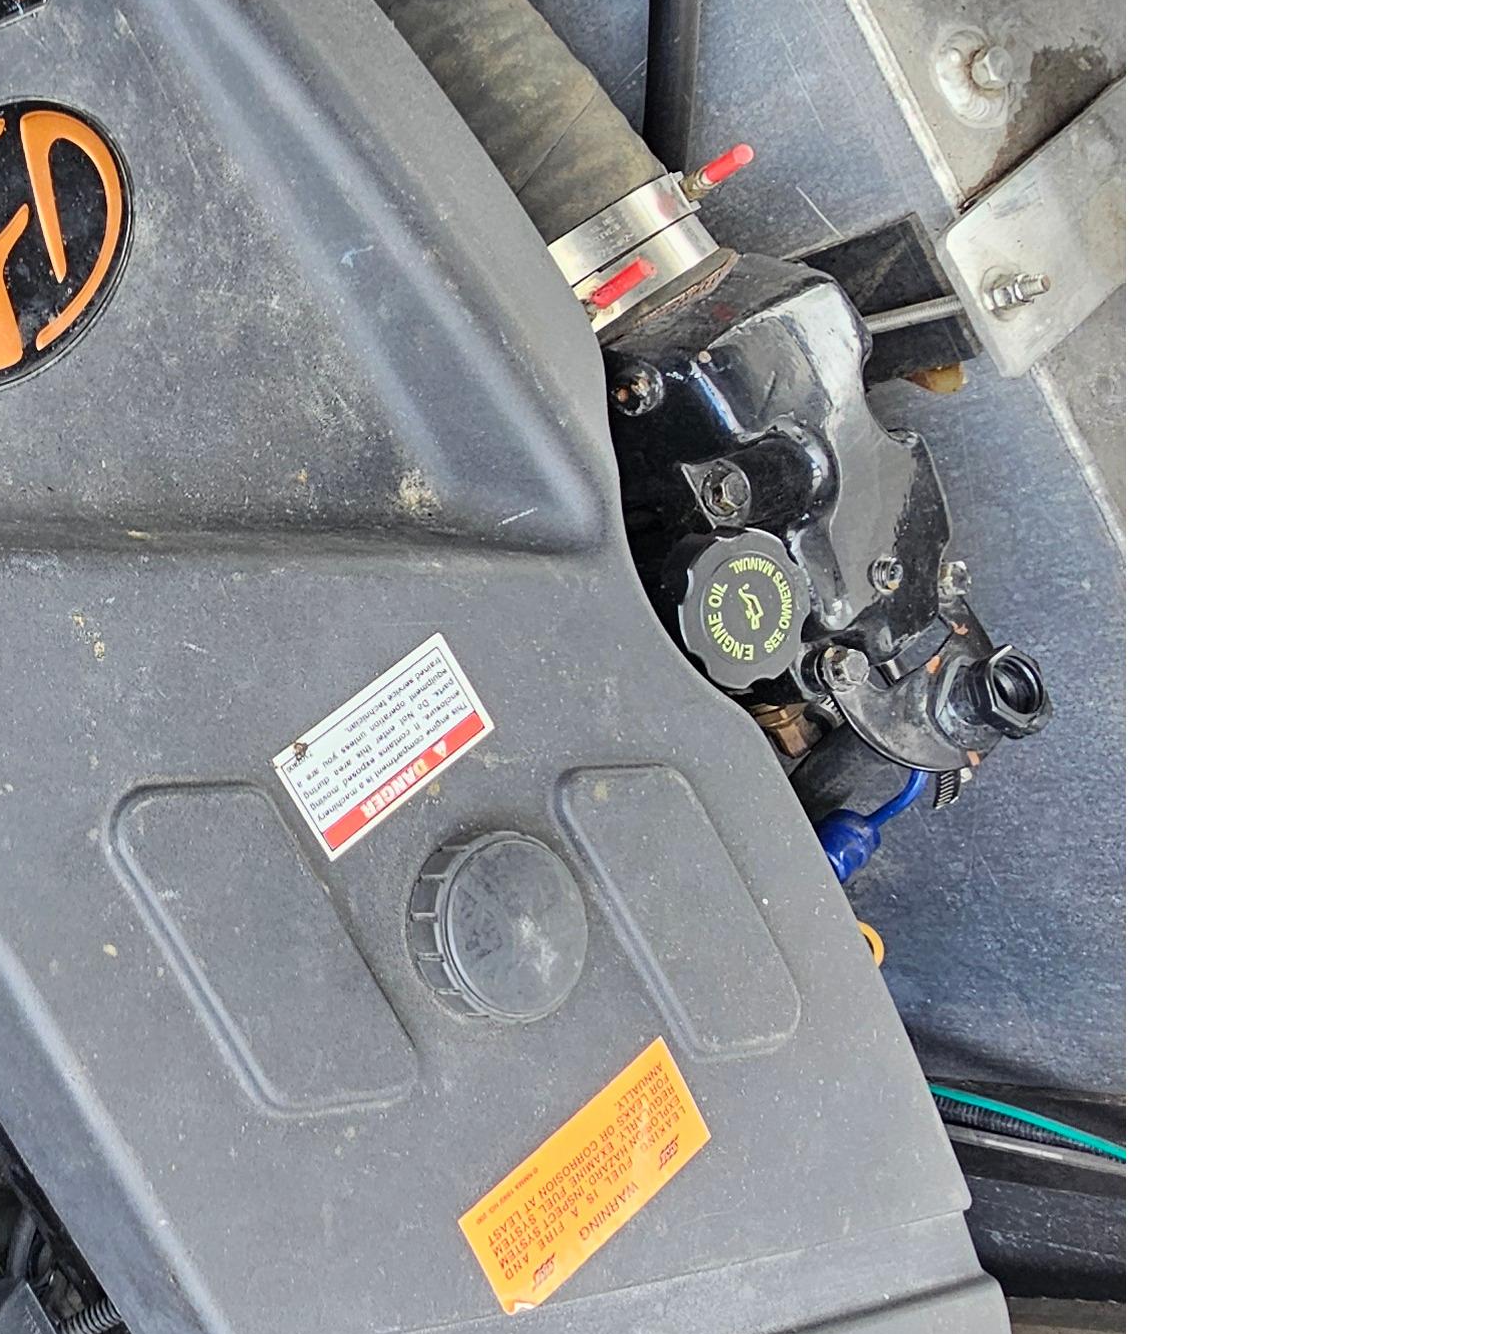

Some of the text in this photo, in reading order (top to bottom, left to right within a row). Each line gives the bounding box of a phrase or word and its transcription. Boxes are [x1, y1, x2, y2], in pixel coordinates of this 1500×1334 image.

[729, 556, 792, 653] SEE OWNER'S MANUAL
[708, 583, 754, 660] ENGINE OIL
[343, 655, 441, 736] trained service technician.
[407, 665, 448, 702] equipment
[431, 676, 455, 699] parts.
[367, 698, 406, 733] operation
[398, 709, 414, 726] Not
[415, 697, 429, 712] Do
[422, 688, 461, 723] enclosure.
[450, 700, 467, 717] This
[373, 723, 396, 744] enter
[424, 712, 450, 737] engine
[339, 730, 366, 755] unless
[354, 743, 371, 760] this
[372, 732, 425, 778] compartment
[377, 728, 411, 759] contains
[304, 767, 319, 781] are
[321, 752, 338, 768] you
[332, 758, 352, 776] area
[340, 754, 376, 787] exposed
[302, 774, 330, 801] during
[308, 783, 340, 812] moving
[315, 785, 359, 823] machinery
[361, 760, 428, 816] DANGER
[614, 1060, 663, 1112] ANNUALLY.
[639, 1104, 685, 1153] LEAKING
[485, 1071, 669, 1248] FOR LEAKS OR CORROSION AT LEAST
[568, 1140, 613, 1187] EXAMINE
[585, 1143, 627, 1187] HAZARD.
[604, 1154, 633, 1187] FUEL
[538, 1184, 566, 1216] FUEL
[540, 1183, 584, 1230] INSPECT
[570, 1205, 579, 1218] A
[579, 1183, 638, 1241] WARNING
[585, 1187, 598, 1205] IS
[492, 1212, 536, 1259] SYSTEM
[497, 1224, 541, 1270] SYSTEM
[536, 1219, 564, 1250] FIRE
[503, 1252, 529, 1281] AND
